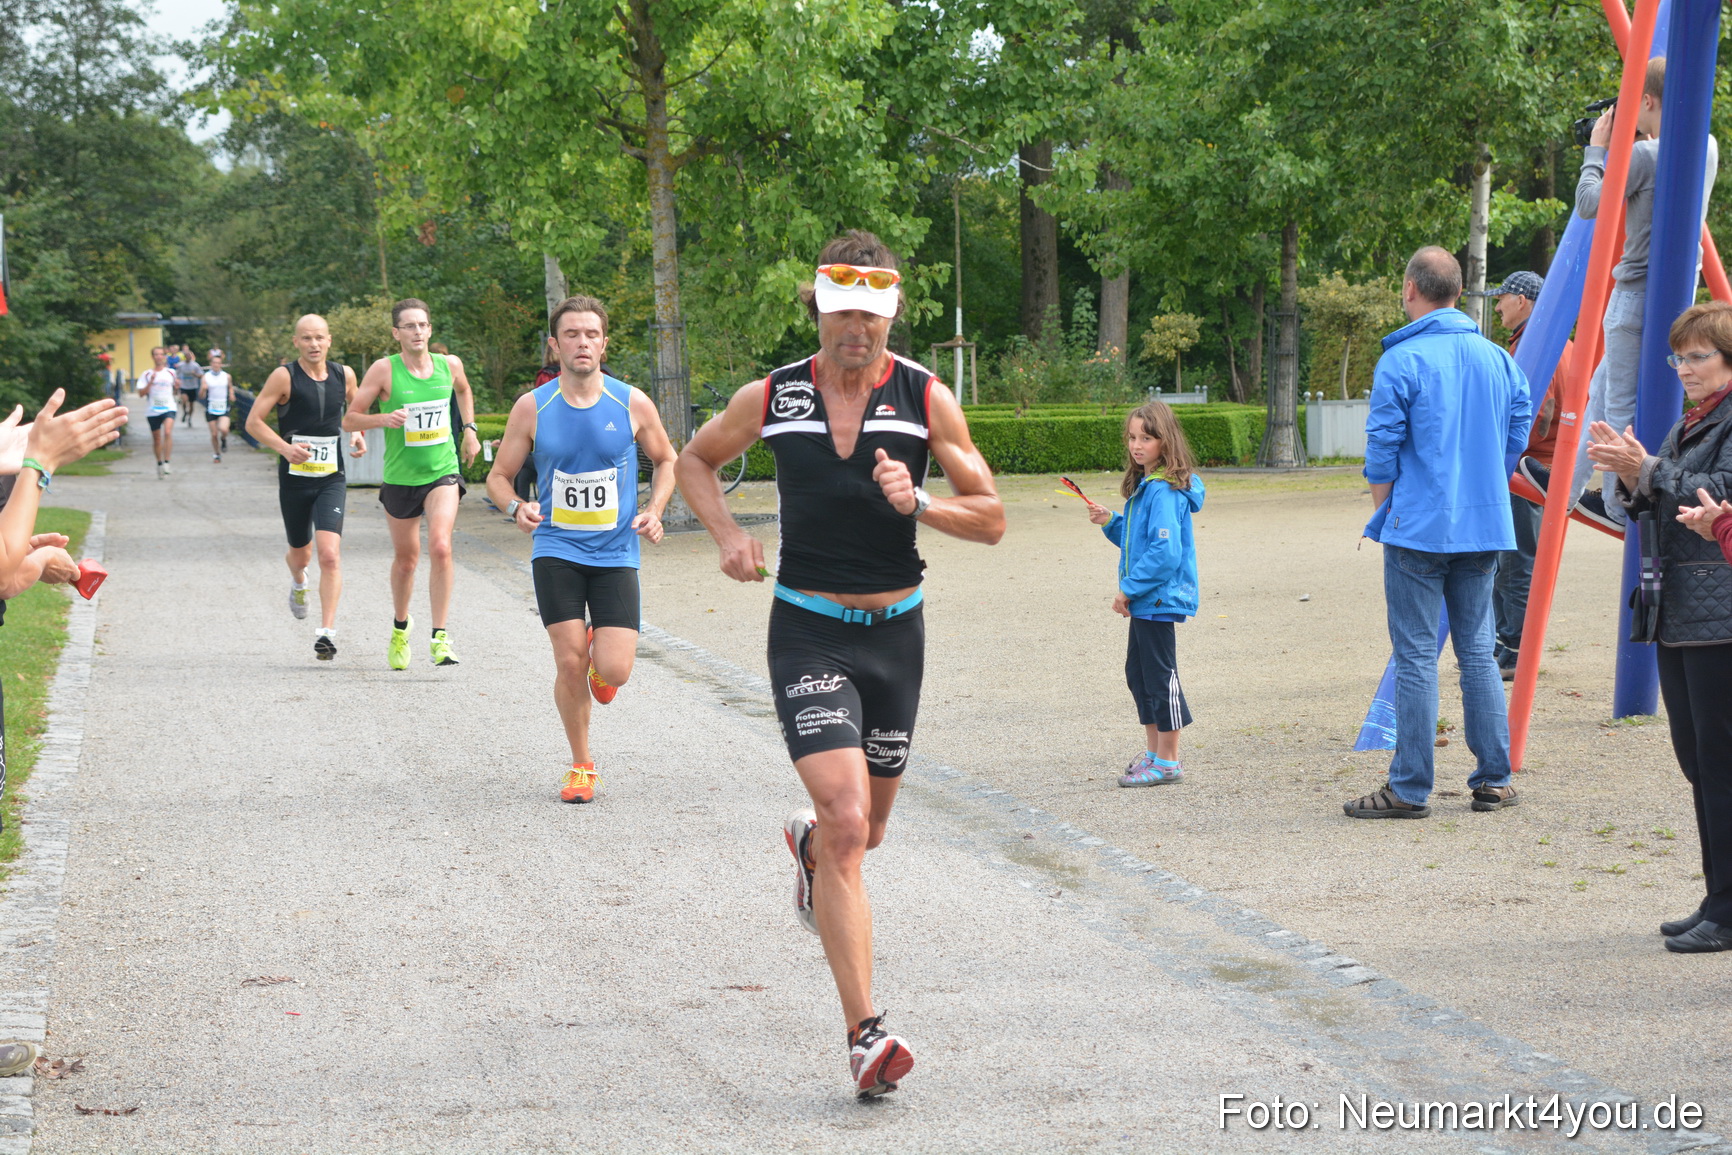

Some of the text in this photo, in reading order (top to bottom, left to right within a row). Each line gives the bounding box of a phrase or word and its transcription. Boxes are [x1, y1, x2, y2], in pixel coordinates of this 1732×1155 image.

[778, 395, 811, 410] Dümig
[414, 410, 442, 429] 177
[419, 432, 439, 440] Martin
[307, 446, 328, 461] 10
[302, 463, 325, 472] Thomas
[575, 476, 607, 485] Neumarkt
[565, 486, 606, 509] 619
[796, 718, 843, 729] Endurance
[798, 727, 822, 736] Team
[866, 742, 907, 758] Dümig
